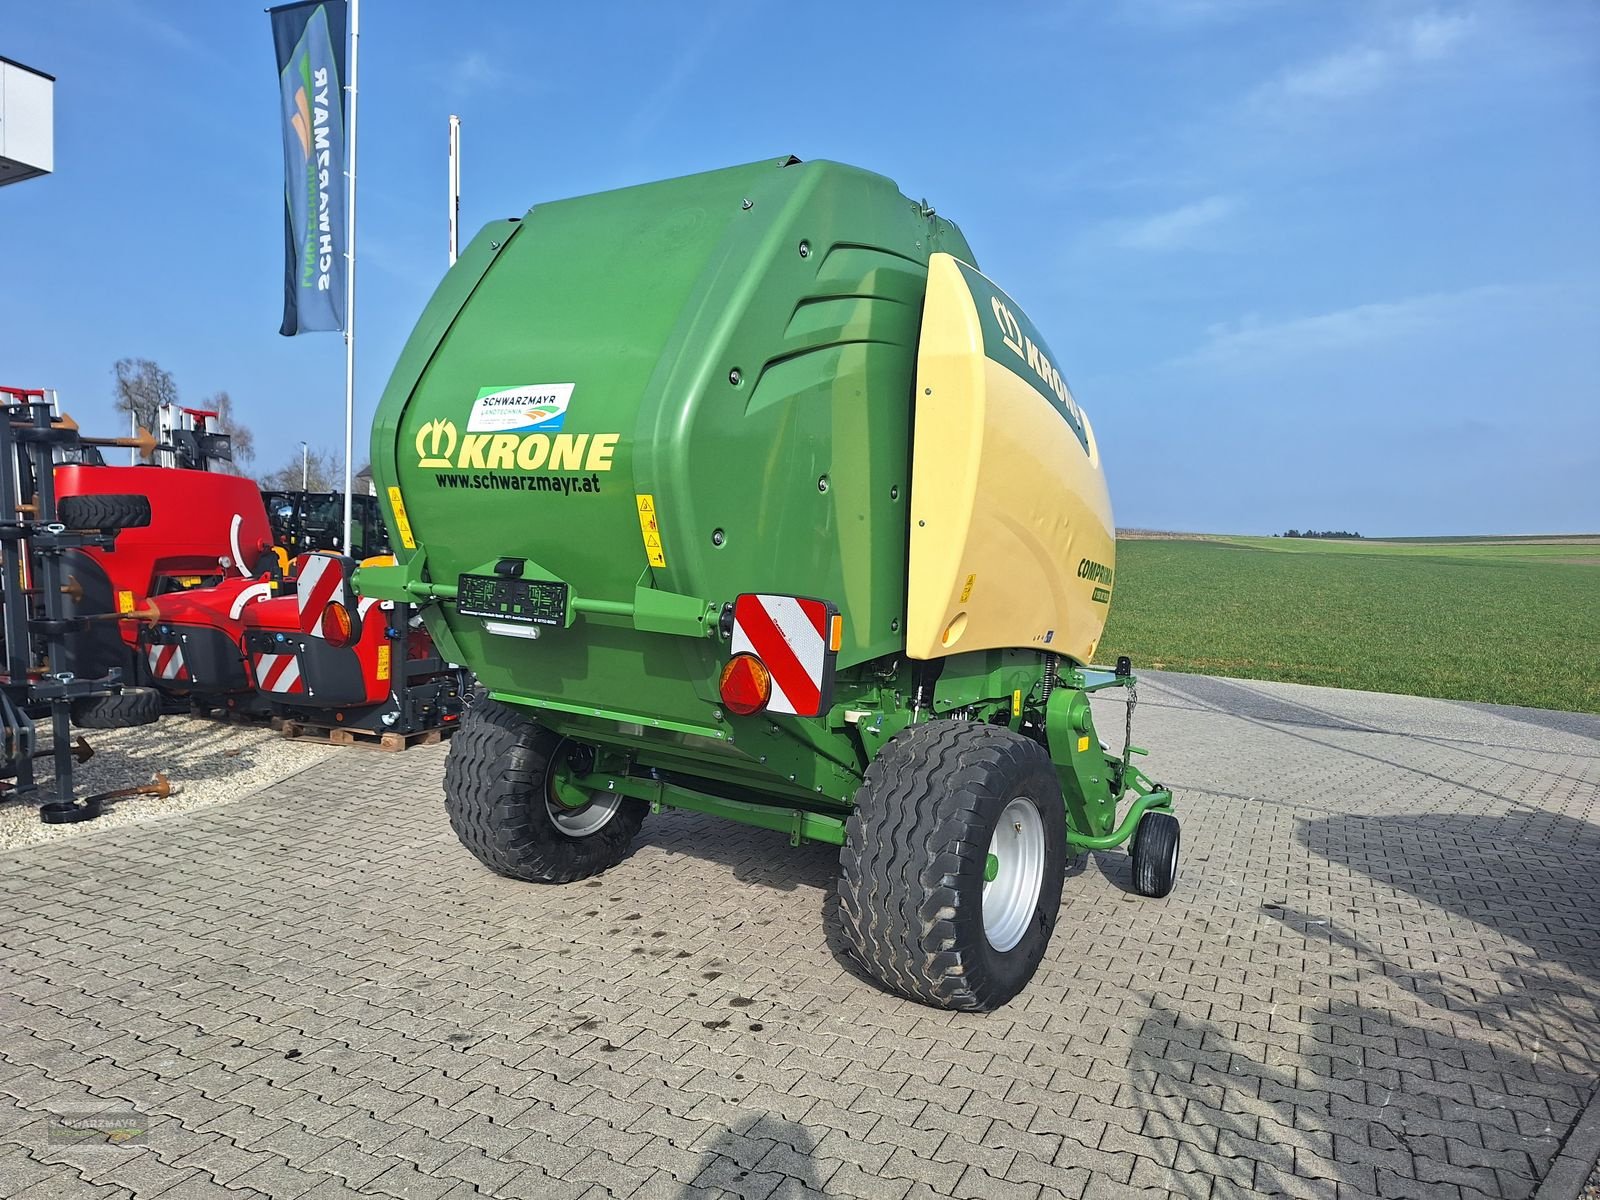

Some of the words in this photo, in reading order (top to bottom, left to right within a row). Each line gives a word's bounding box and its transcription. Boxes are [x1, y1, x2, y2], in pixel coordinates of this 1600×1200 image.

[482, 395, 556, 407] SCHWARZMAYR
[457, 433, 620, 471] KRONE
[435, 471, 600, 496] www.schwarzmayr.at
